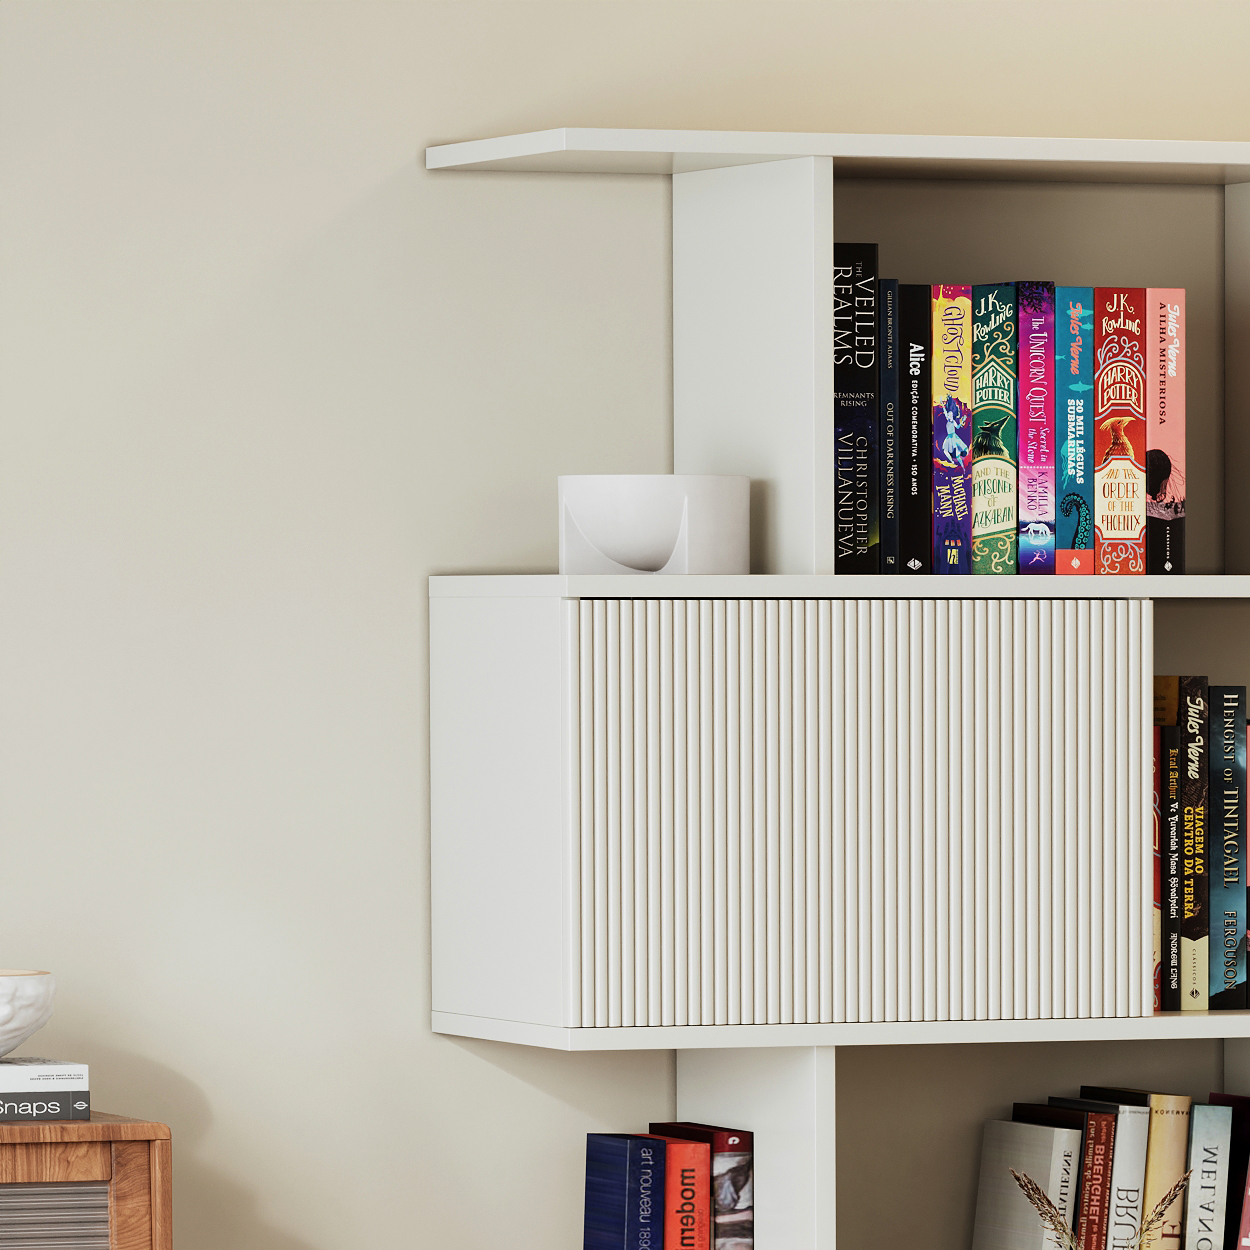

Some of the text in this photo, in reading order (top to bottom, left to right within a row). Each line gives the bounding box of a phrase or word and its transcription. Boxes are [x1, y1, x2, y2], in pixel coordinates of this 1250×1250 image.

[833, 266, 853, 365] REALMS
[855, 261, 875, 369] THE VEILED
[909, 343, 925, 376] Alice
[1068, 301, 1083, 376] Jules Verne
[1167, 303, 1180, 378] Jules Verne
[975, 366, 1010, 390] HARRY
[1026, 316, 1048, 425] The UNICORN QUEST
[1103, 366, 1139, 390] HARRY
[1159, 302, 1167, 425] A ILHA MISTERIOSA
[910, 380, 919, 404] EDIÇÃO
[976, 387, 1010, 404] POTTER
[1103, 383, 1139, 406] POTTER
[1027, 428, 1038, 464] the Stone
[1039, 427, 1050, 463] Secret in
[1067, 398, 1076, 476] SUBMARINAS
[1075, 398, 1086, 485] 20 MIL LÉGUAS
[886, 402, 894, 519] OUT OF DARKNESS RISING
[975, 466, 1010, 481] AND THE
[1101, 468, 1140, 480] AND THE
[838, 432, 854, 558] VILLANUEVA
[855, 436, 868, 555] CHRISTOPHER
[936, 484, 954, 518] MANN
[951, 474, 968, 521] MICHAEL
[972, 478, 1014, 499] PRISONER
[987, 495, 999, 508] OF
[1027, 478, 1038, 511] BENKO
[1038, 471, 1049, 517] KAMILLA
[1102, 482, 1140, 500] ORDER
[1107, 501, 1135, 512] OF THE
[972, 506, 1014, 529] AZKABAN
[1101, 514, 1141, 532] PHOENIX
[1187, 696, 1204, 780] Jules Verne
[1223, 694, 1240, 889] HENGIST OF TINTAGAEL
[1168, 771, 1179, 875] Arthur Masa
[1194, 806, 1204, 874] VIAGEM AO
[1184, 806, 1194, 919] CENTRO DA TERRA
[1223, 910, 1237, 990] FERGUSON
[640, 1147, 654, 1165] art
[639, 1169, 653, 1223] nouveau
